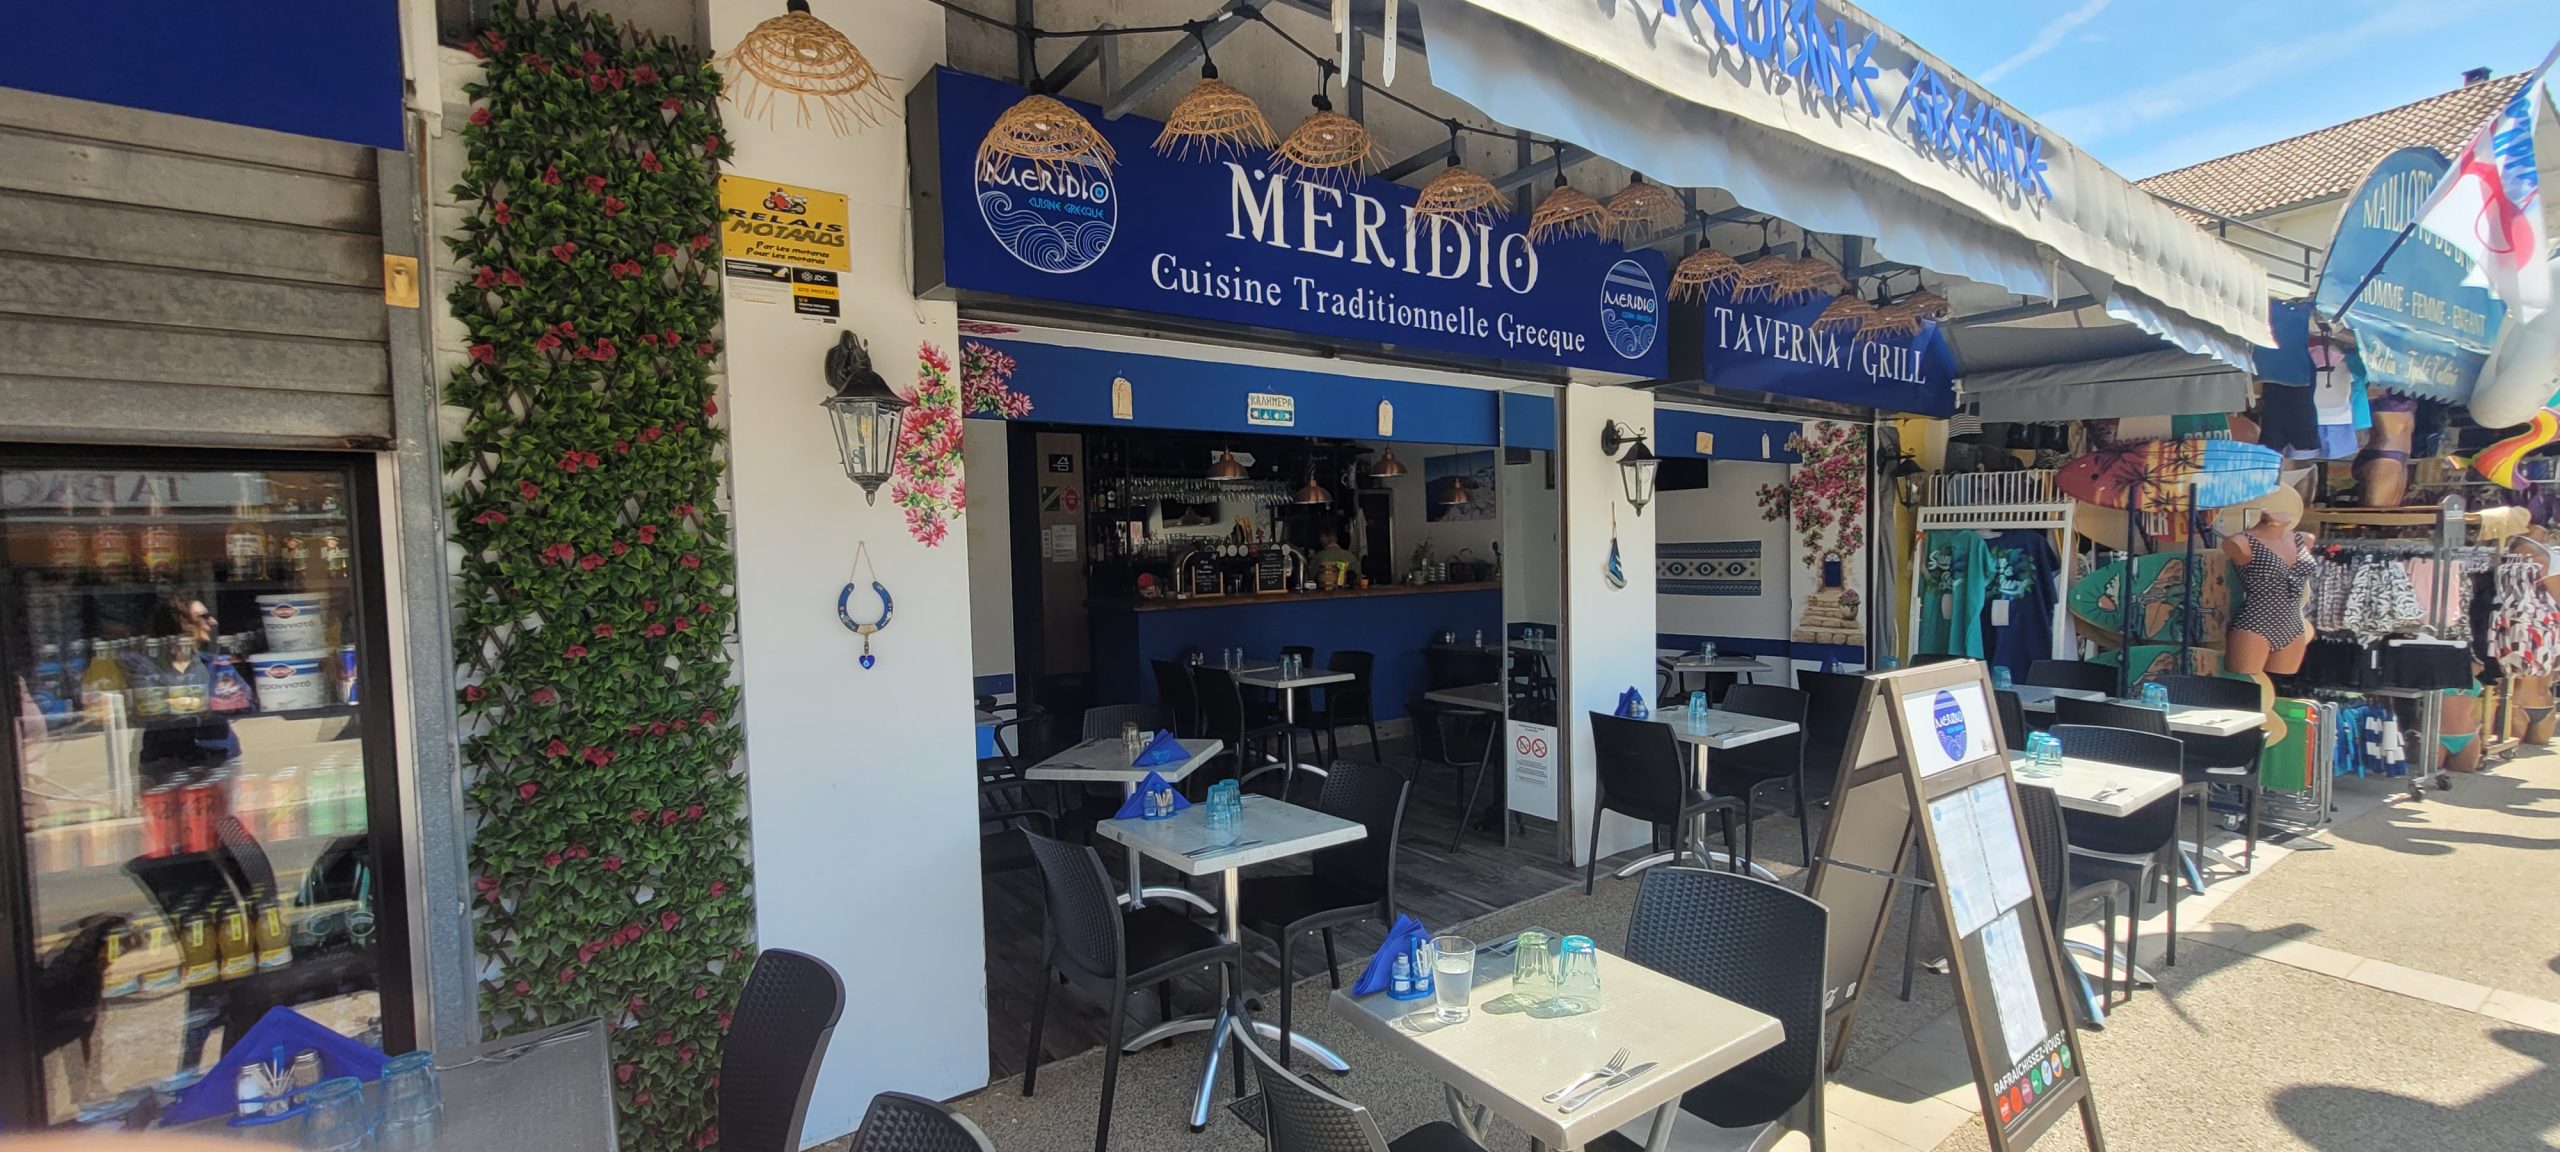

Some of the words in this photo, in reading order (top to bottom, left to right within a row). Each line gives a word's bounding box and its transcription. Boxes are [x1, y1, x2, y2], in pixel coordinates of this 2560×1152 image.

[1907, 58, 2052, 201] GRECQUE
[984, 162, 1109, 204] MERIDIO
[728, 208, 842, 232] RELAIS
[1028, 197, 1062, 211] CUISINE
[1063, 203, 1105, 219] GRECQUE
[729, 220, 845, 248] MOTARDS
[1223, 161, 1538, 294] MERIDIO
[746, 247, 769, 257] Pour
[788, 255, 825, 265] motards
[756, 241, 774, 250] Par
[792, 247, 829, 258] motards
[1152, 253, 1282, 306] Cuisine
[1293, 276, 1489, 338] Traditionnelle
[1497, 312, 1586, 357] Grecque
[1604, 290, 1656, 313] MERIDIO
[2360, 276, 2405, 313] HOMME
[2411, 291, 2447, 326] FEMME
[1714, 306, 1841, 369] TAVERNA
[1862, 341, 1927, 385] GRILL
